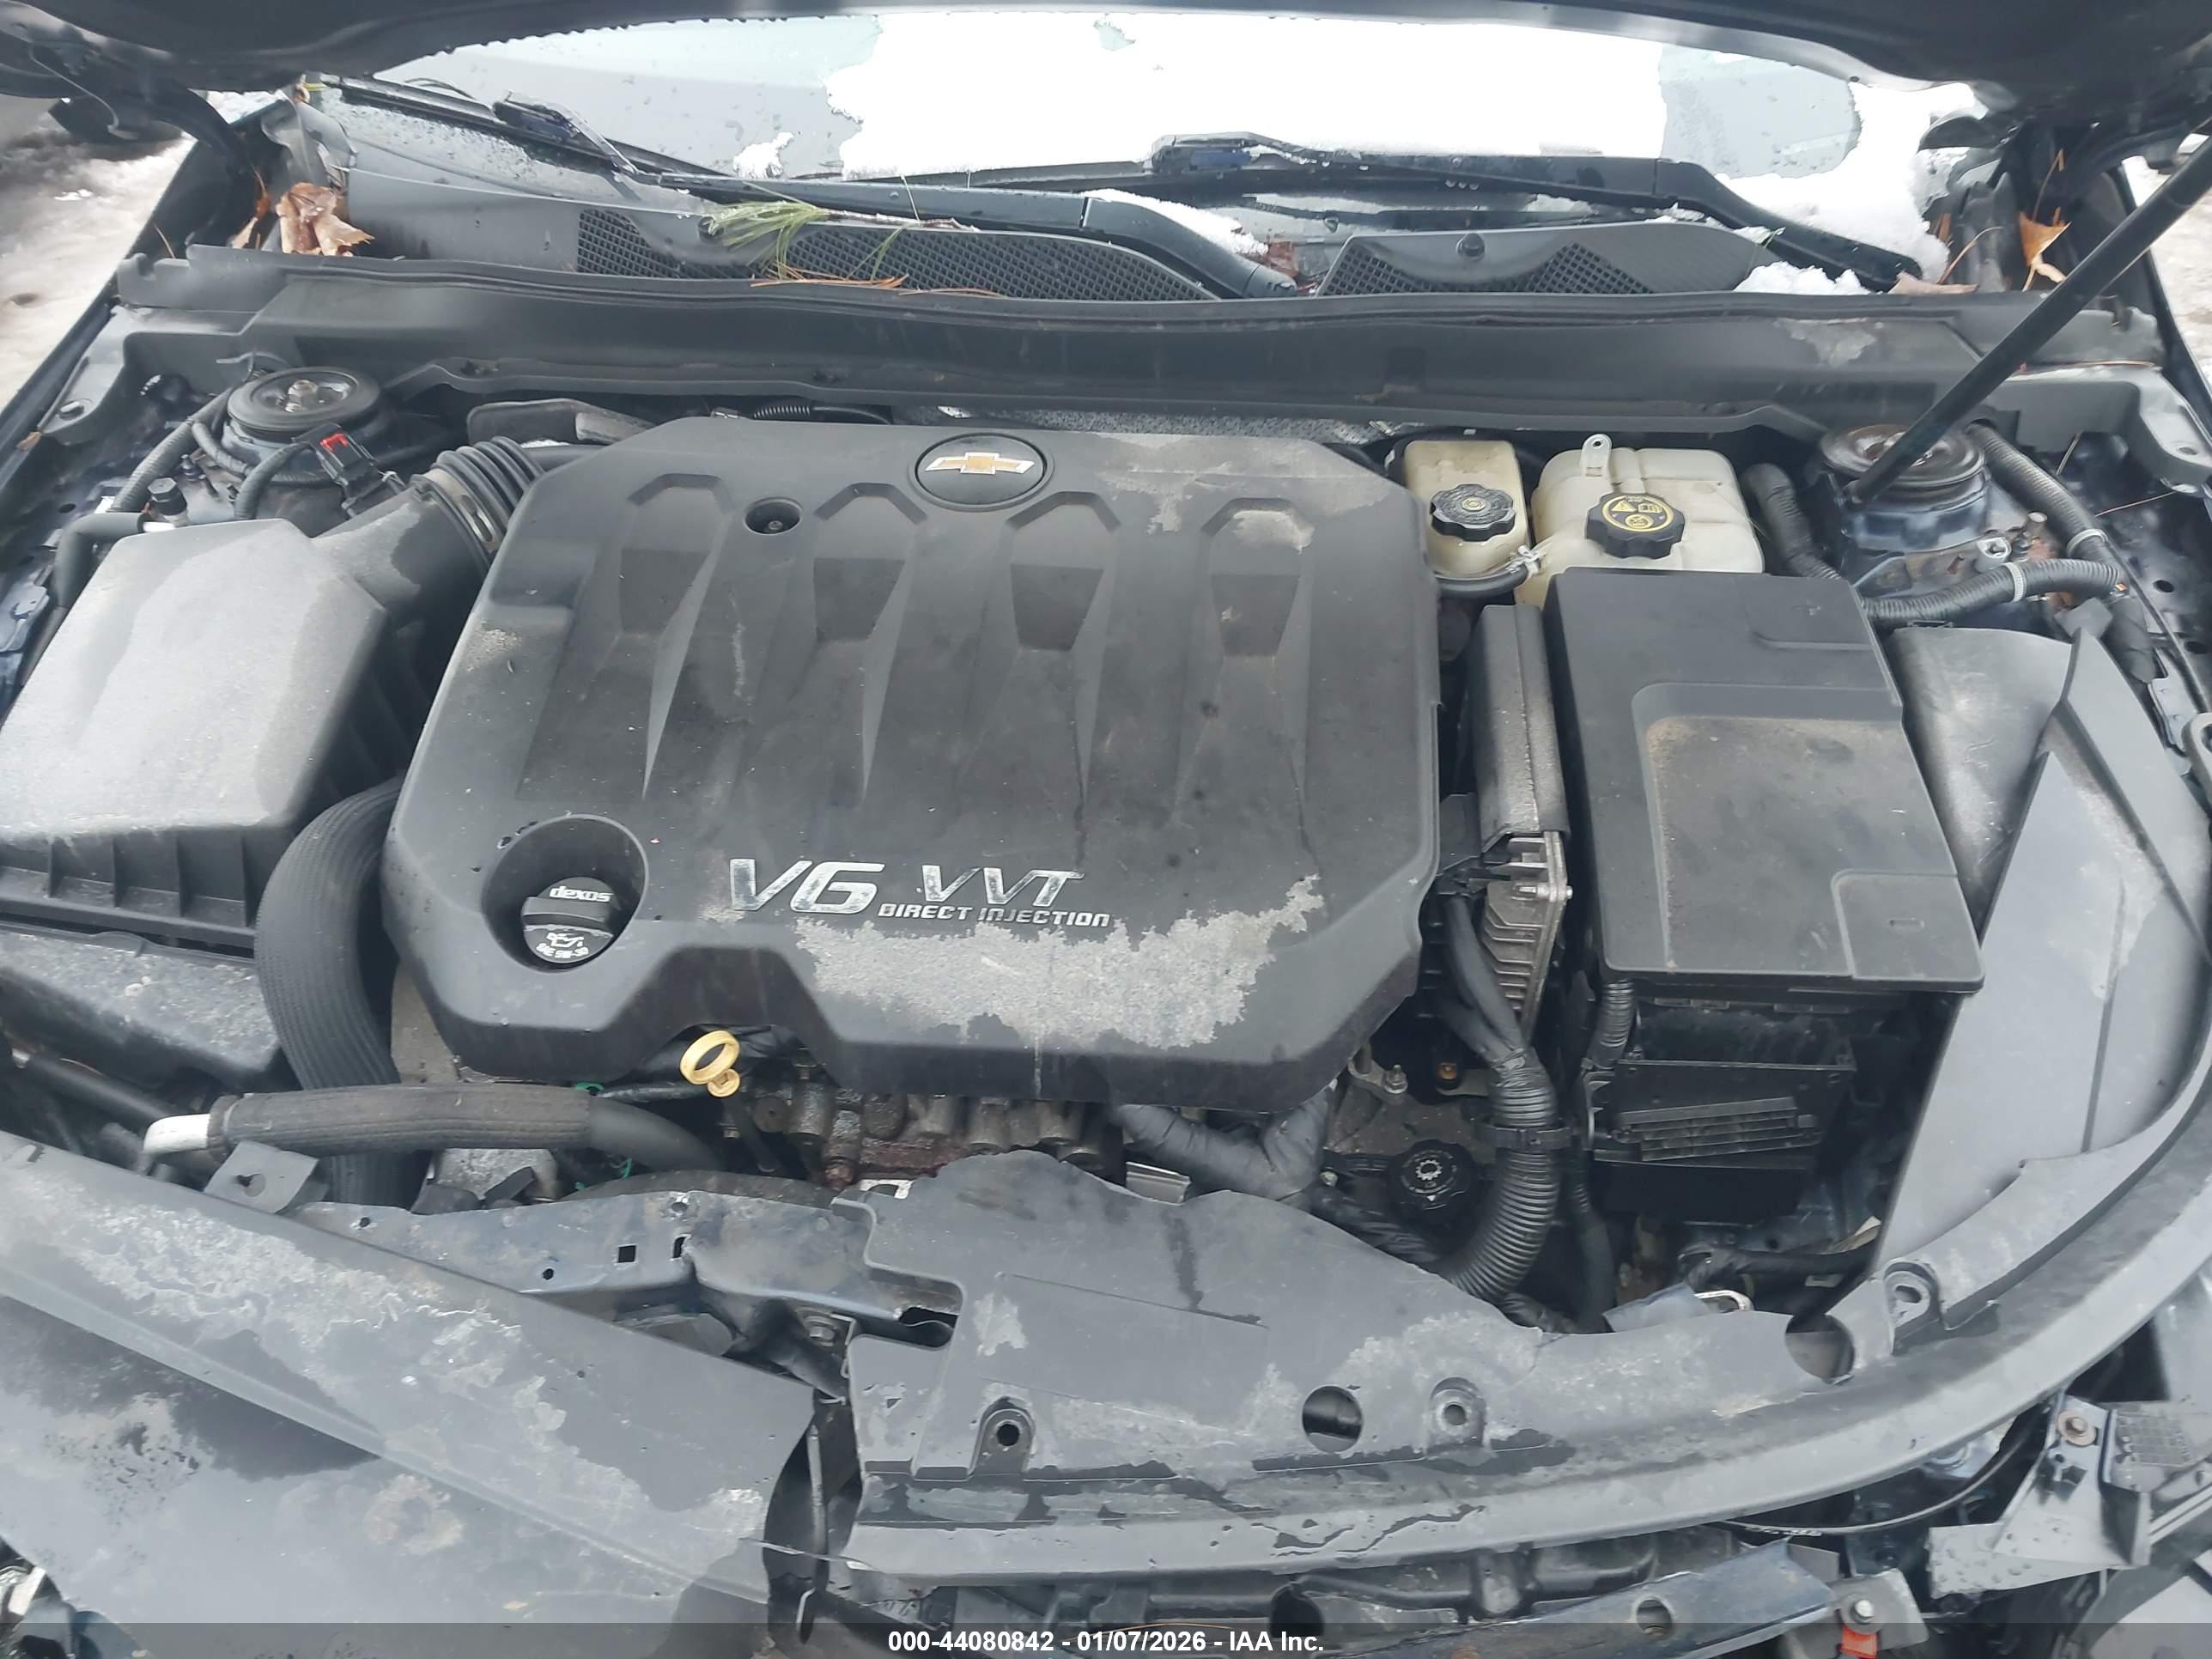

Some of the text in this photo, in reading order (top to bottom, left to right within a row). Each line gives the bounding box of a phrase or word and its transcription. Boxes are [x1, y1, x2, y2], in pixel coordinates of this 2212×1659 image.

[550, 885, 614, 902] dexos
[729, 858, 1085, 915] V6 VVT
[878, 902, 1110, 927] DIRECT INJECTION
